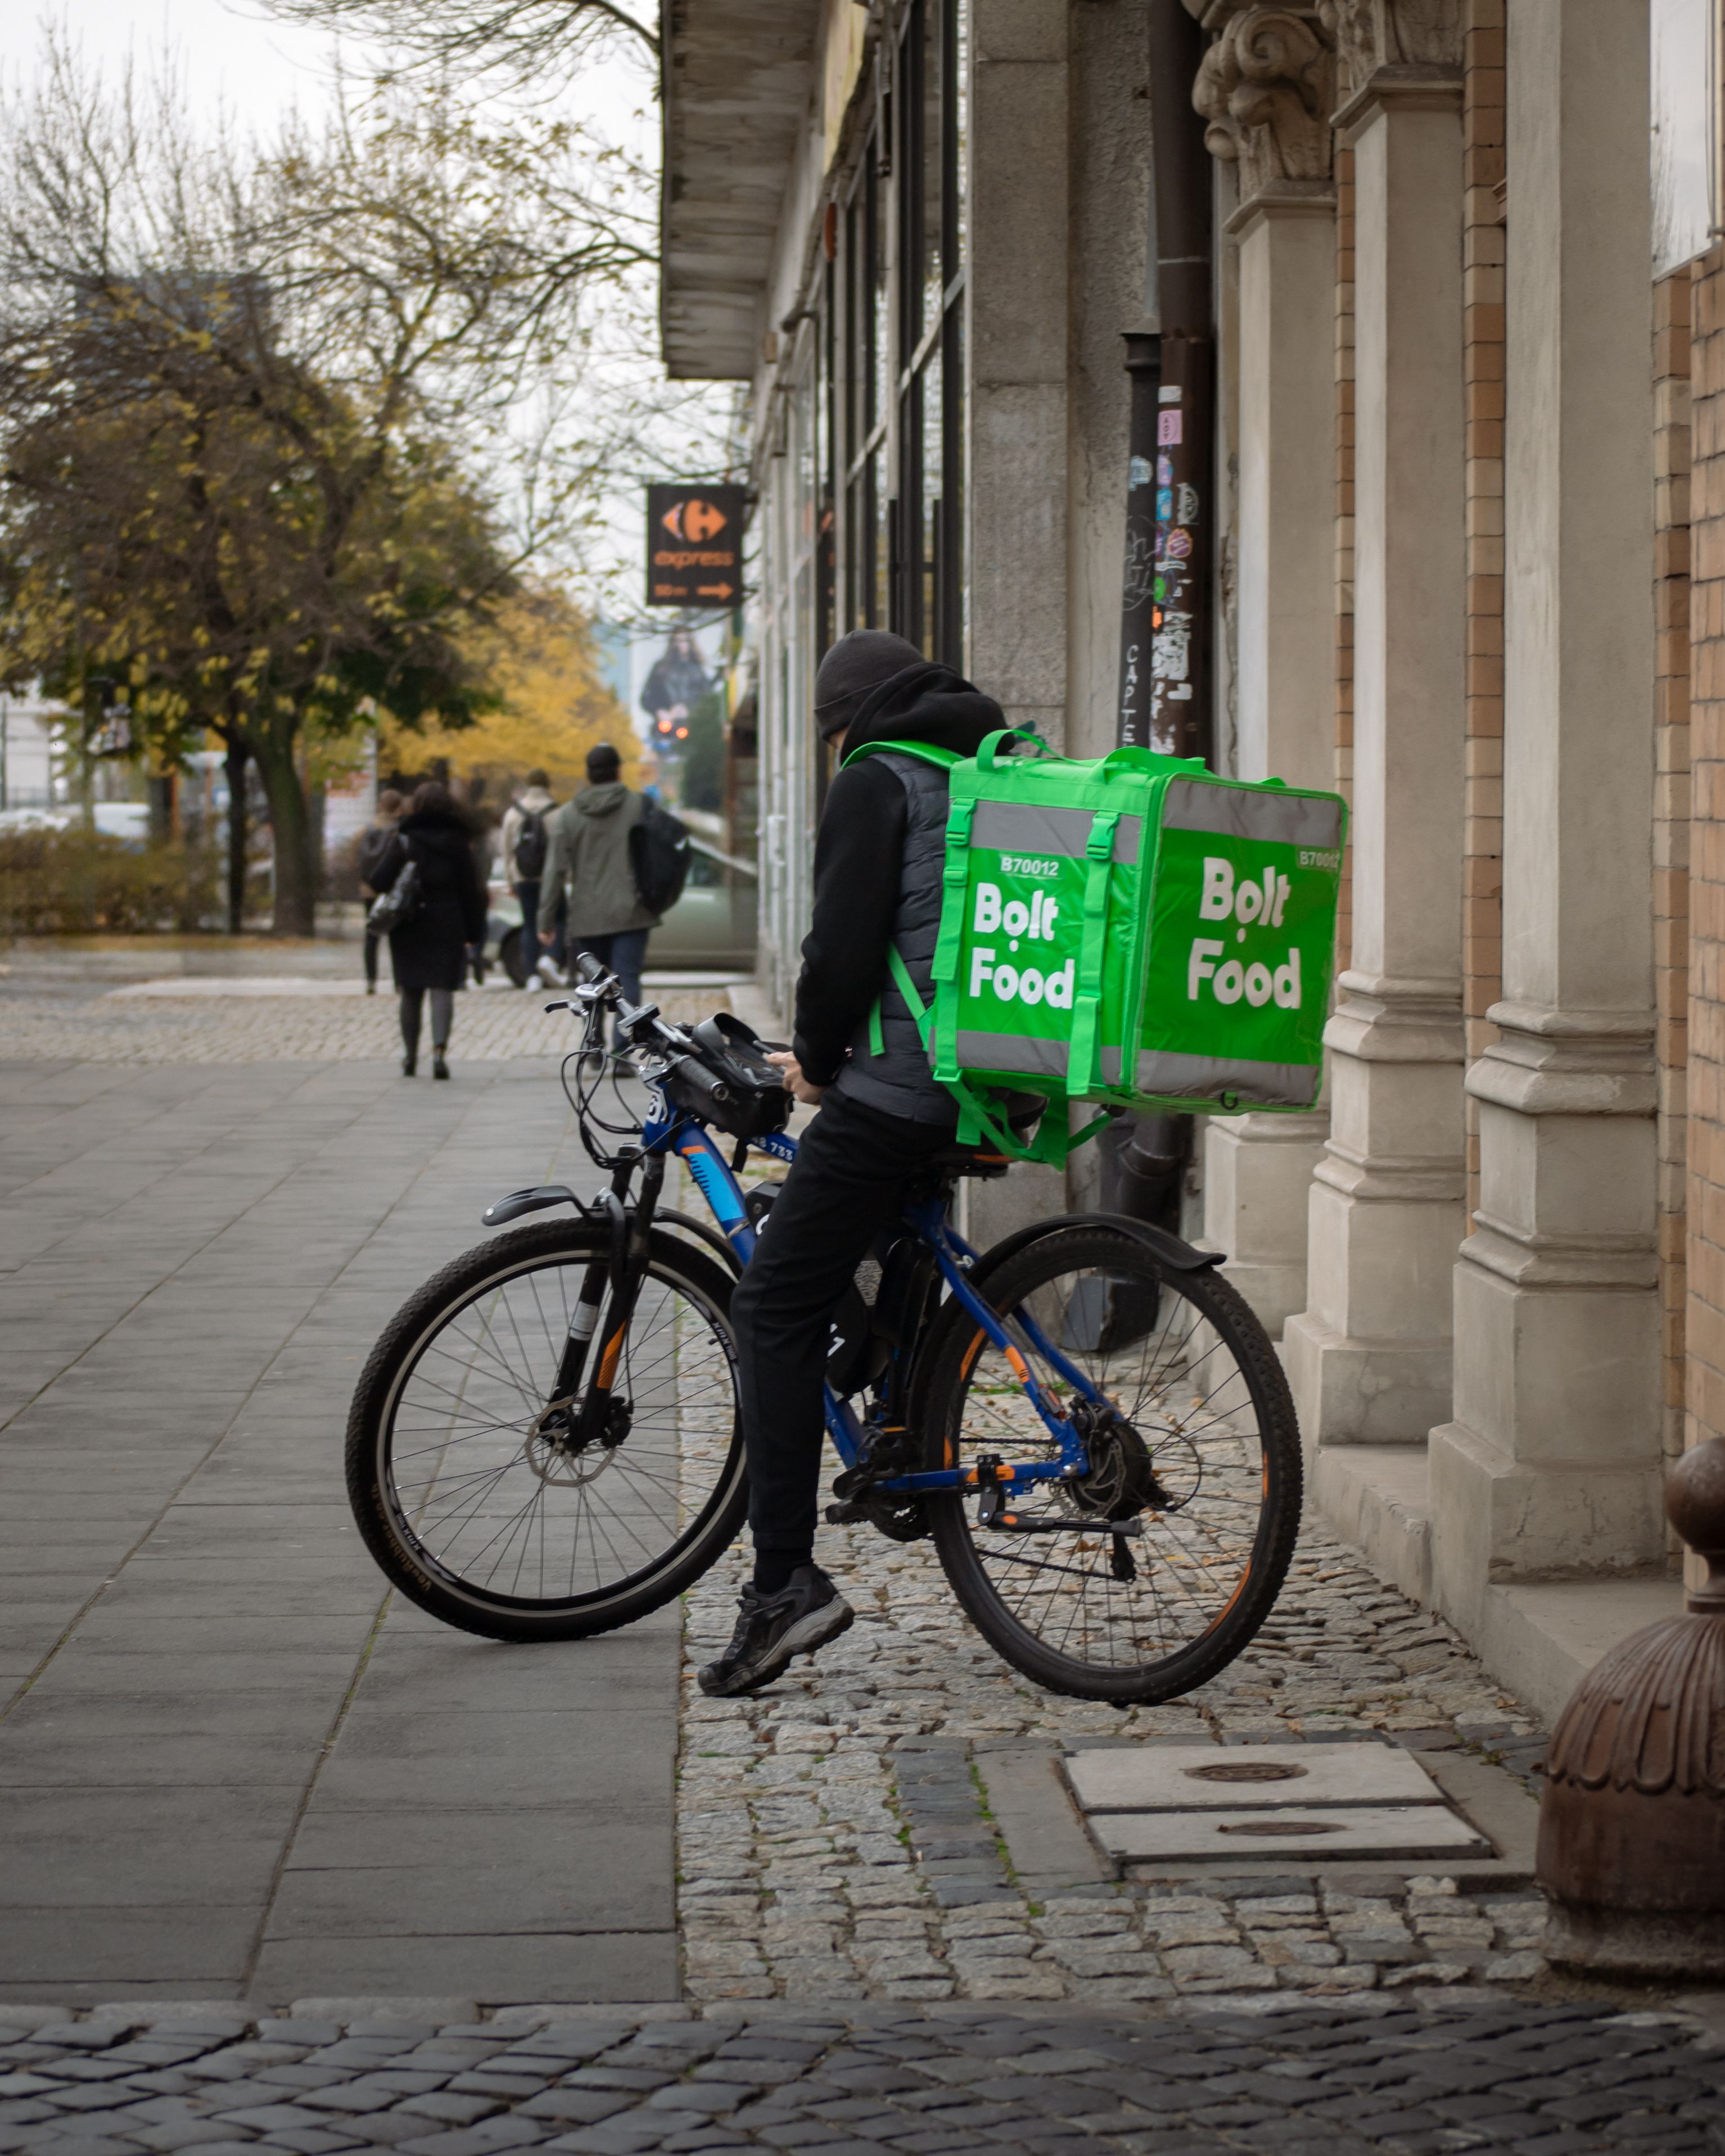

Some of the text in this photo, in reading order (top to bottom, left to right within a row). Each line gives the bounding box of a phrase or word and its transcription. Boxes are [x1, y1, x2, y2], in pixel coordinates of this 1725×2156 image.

[1121, 644, 1139, 747] CAPTE
[1000, 856, 1059, 876] B70012
[1199, 856, 1291, 928] Bolt
[973, 882, 1059, 942] Bolt
[969, 946, 1075, 1010] Food
[1187, 937, 1300, 1010] Food
